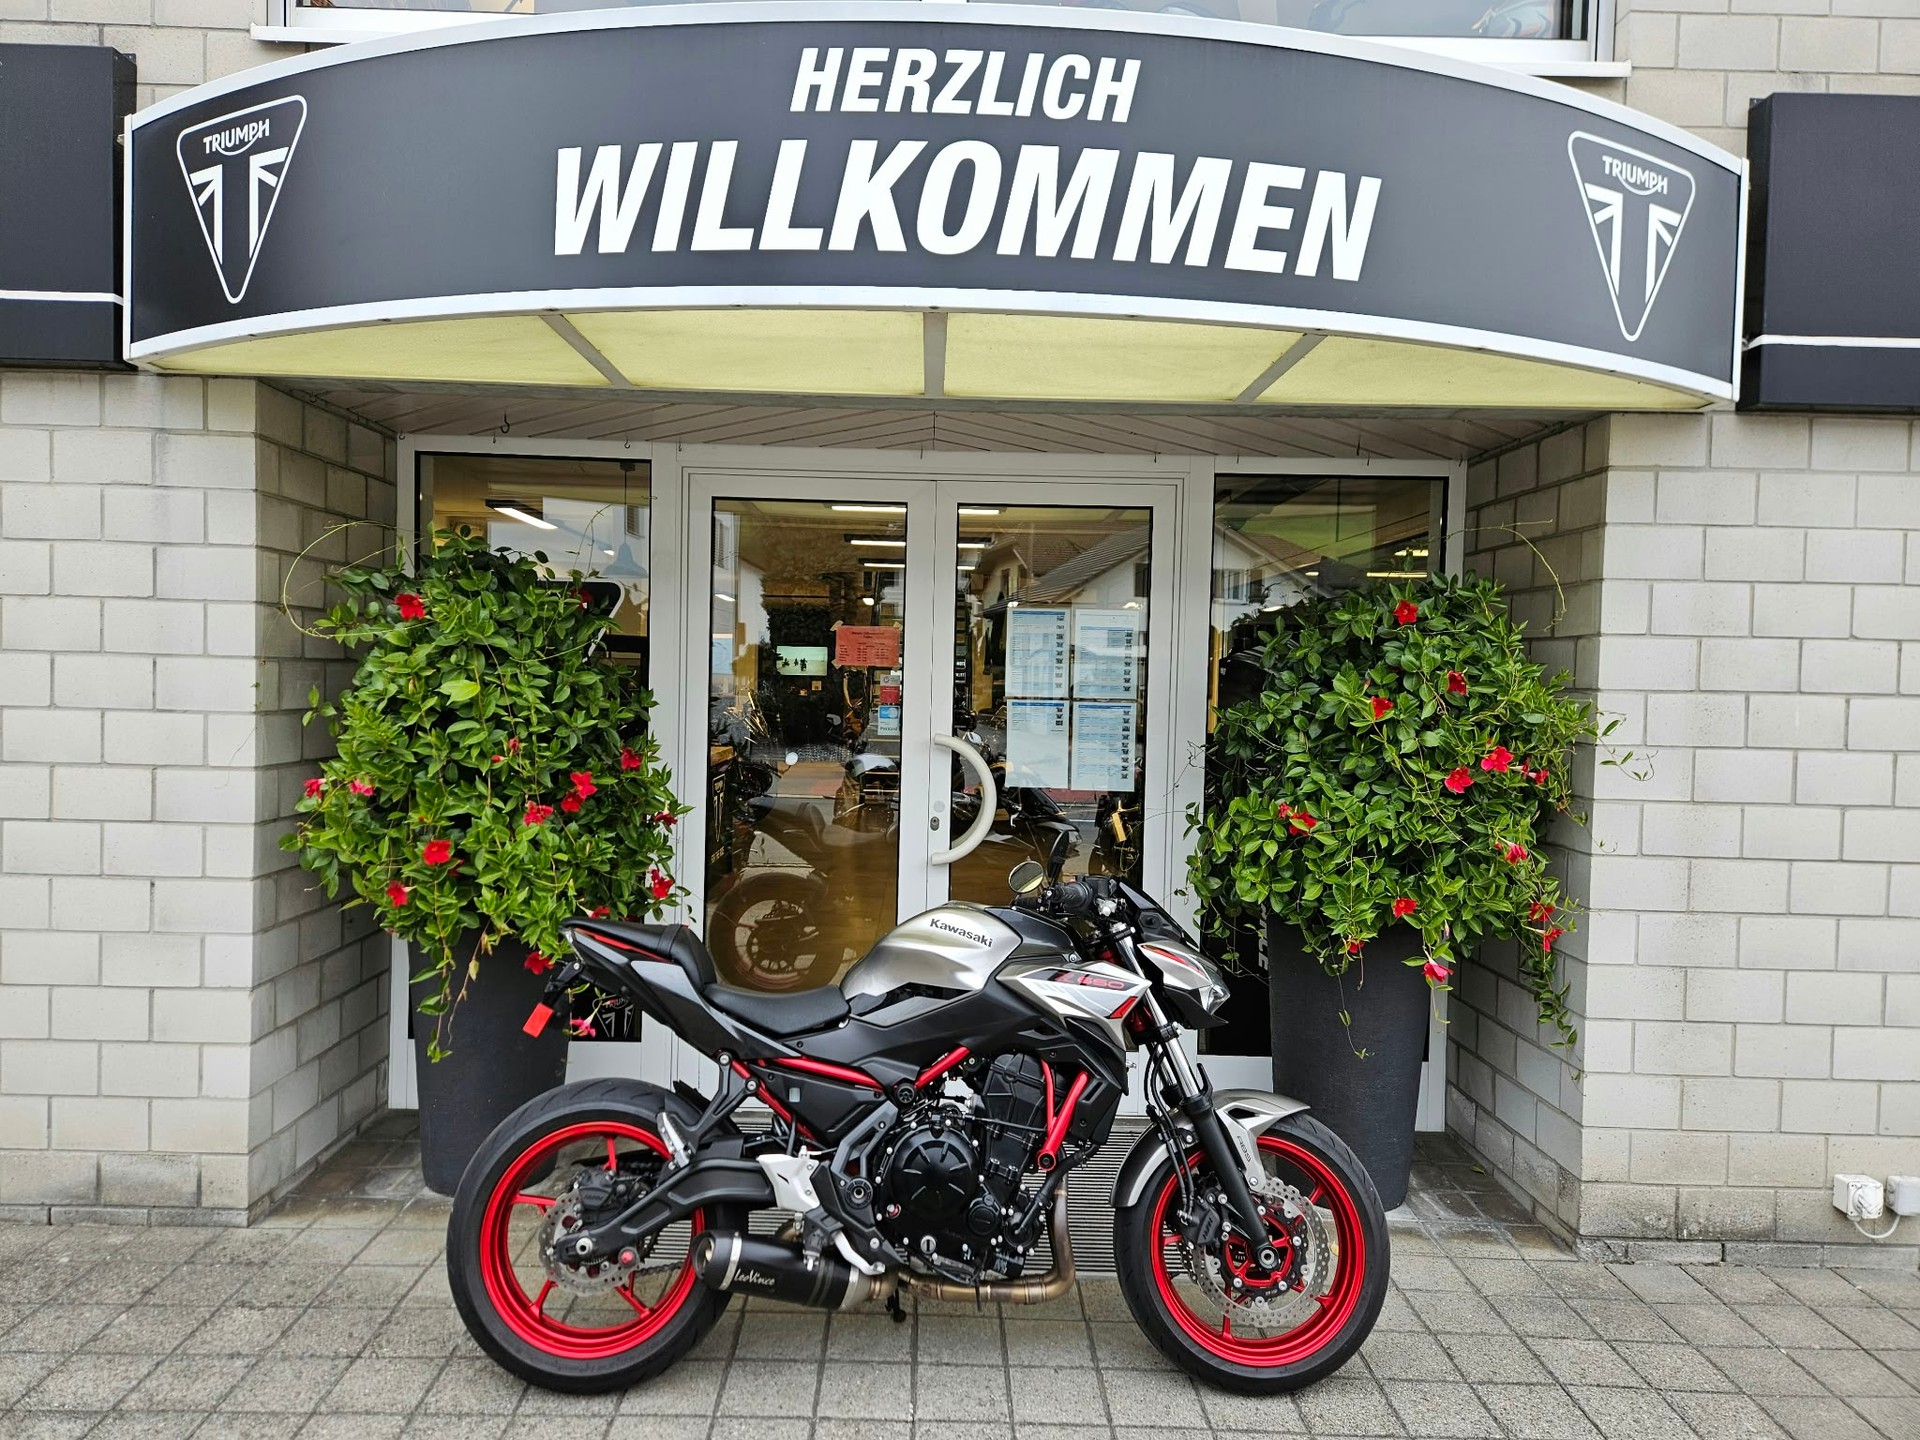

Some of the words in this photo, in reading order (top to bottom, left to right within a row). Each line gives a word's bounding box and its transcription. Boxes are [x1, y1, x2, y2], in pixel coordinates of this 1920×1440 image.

[789, 47, 1141, 124] HERZLICH
[203, 118, 270, 156] TRIUMPH
[1601, 155, 1668, 196] TRIUMPH
[553, 139, 1382, 282] WILLKOMMEN
[929, 917, 993, 948] Kawasaki
[733, 1268, 776, 1286] LeoVince
